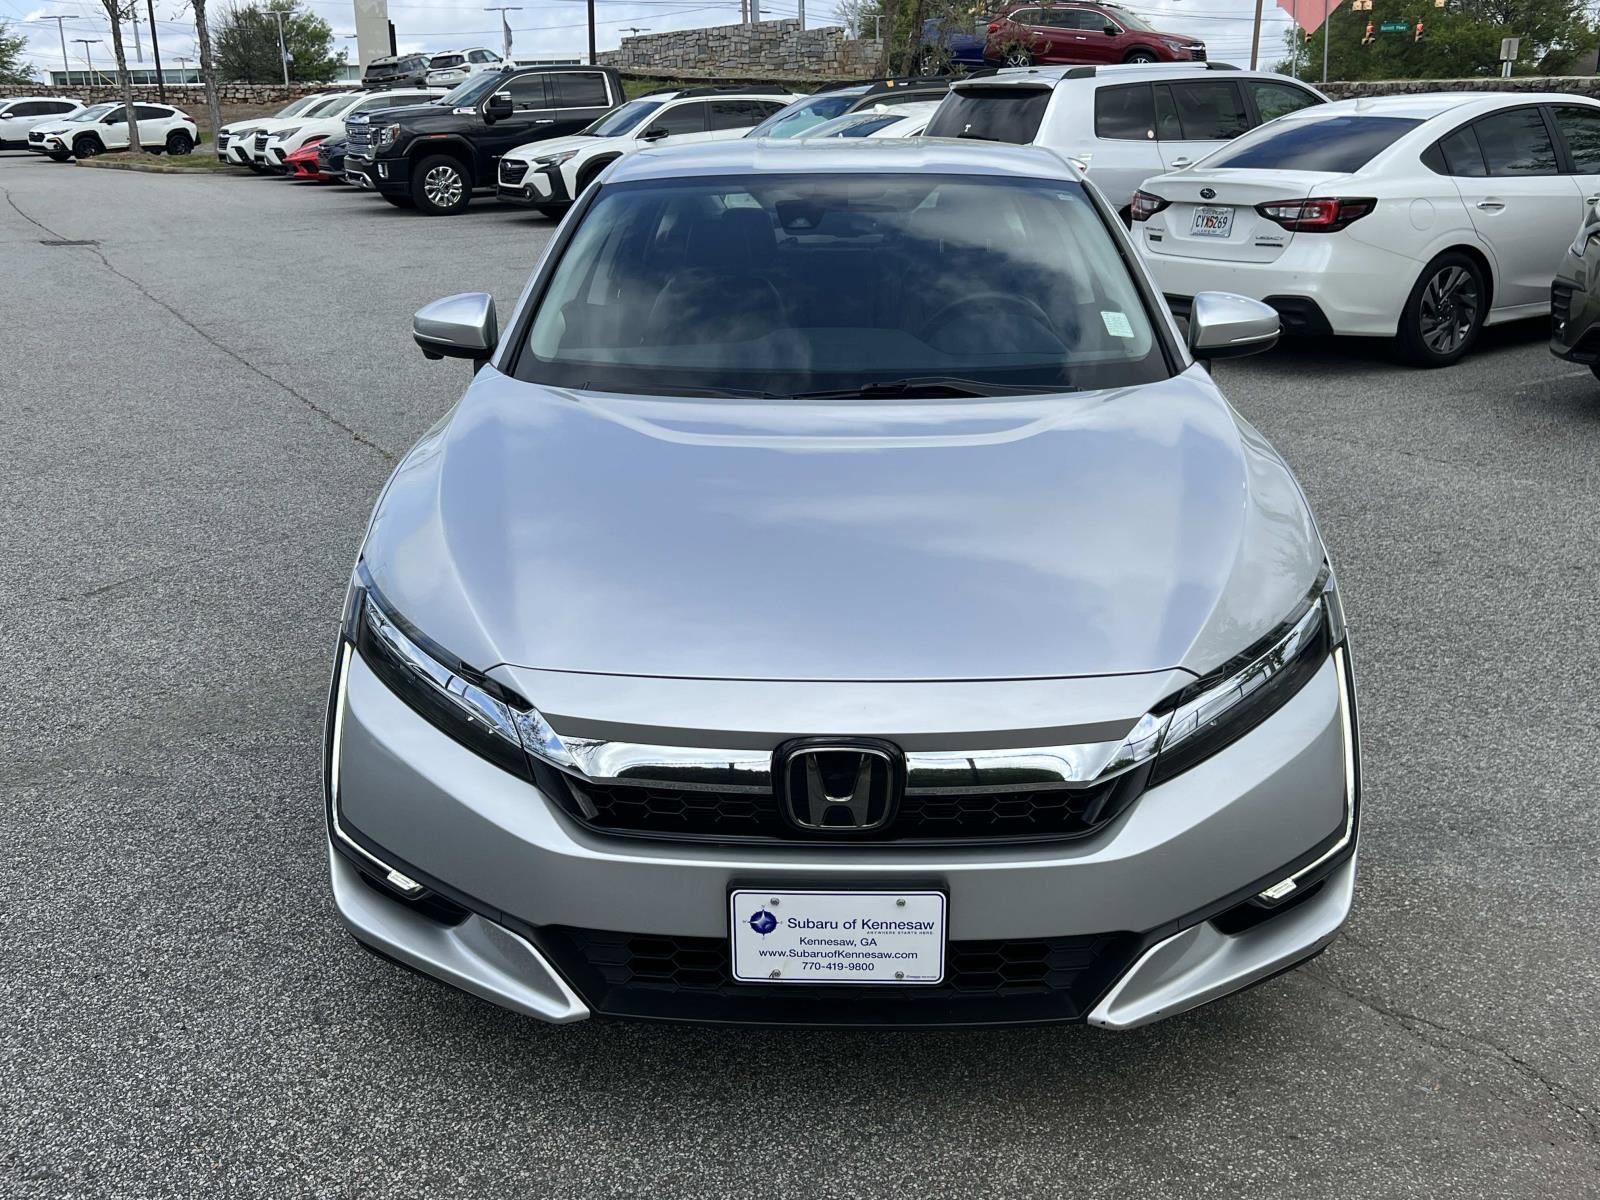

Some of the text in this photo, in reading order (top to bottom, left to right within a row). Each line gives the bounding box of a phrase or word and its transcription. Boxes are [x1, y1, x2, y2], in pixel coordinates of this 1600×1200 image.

[787, 917, 935, 930] Subaru of Kennesaw
[799, 937, 877, 947] Kennesaw, GA
[759, 949, 918, 960] www.SubaruofKennesaw.com
[802, 962, 875, 971] 770-419-9800
